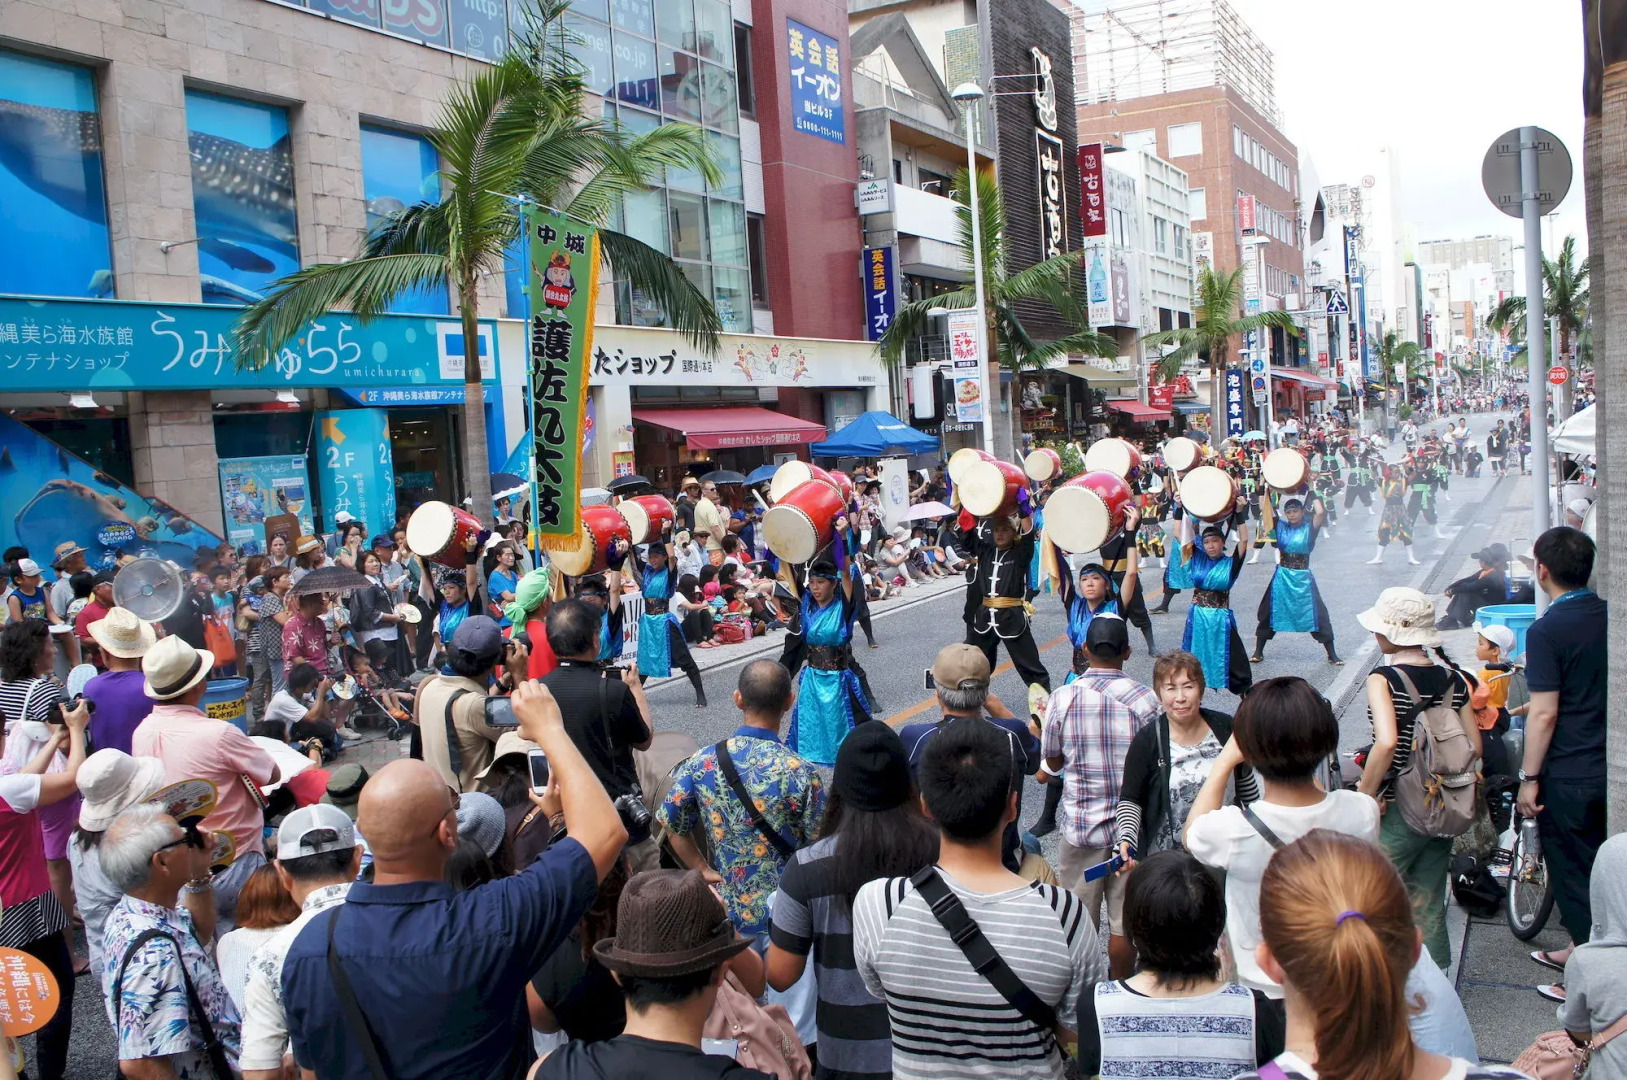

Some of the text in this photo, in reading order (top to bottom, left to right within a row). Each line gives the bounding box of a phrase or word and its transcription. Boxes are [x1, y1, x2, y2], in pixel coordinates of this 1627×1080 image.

[788, 28, 840, 75] 英会話
[791, 66, 841, 102] イーオン
[537, 224, 585, 255] 中城
[0, 323, 134, 346] 縄美ら海水族館
[5, 351, 130, 370] ンテナショップ
[344, 365, 420, 378] umichurara
[589, 346, 677, 376] たショップ
[368, 389, 488, 401] 2F 沖縄美ら海水族館アンテナプ
[327, 447, 355, 468] 2F
[5, 955, 36, 1024] 沖縄には今
